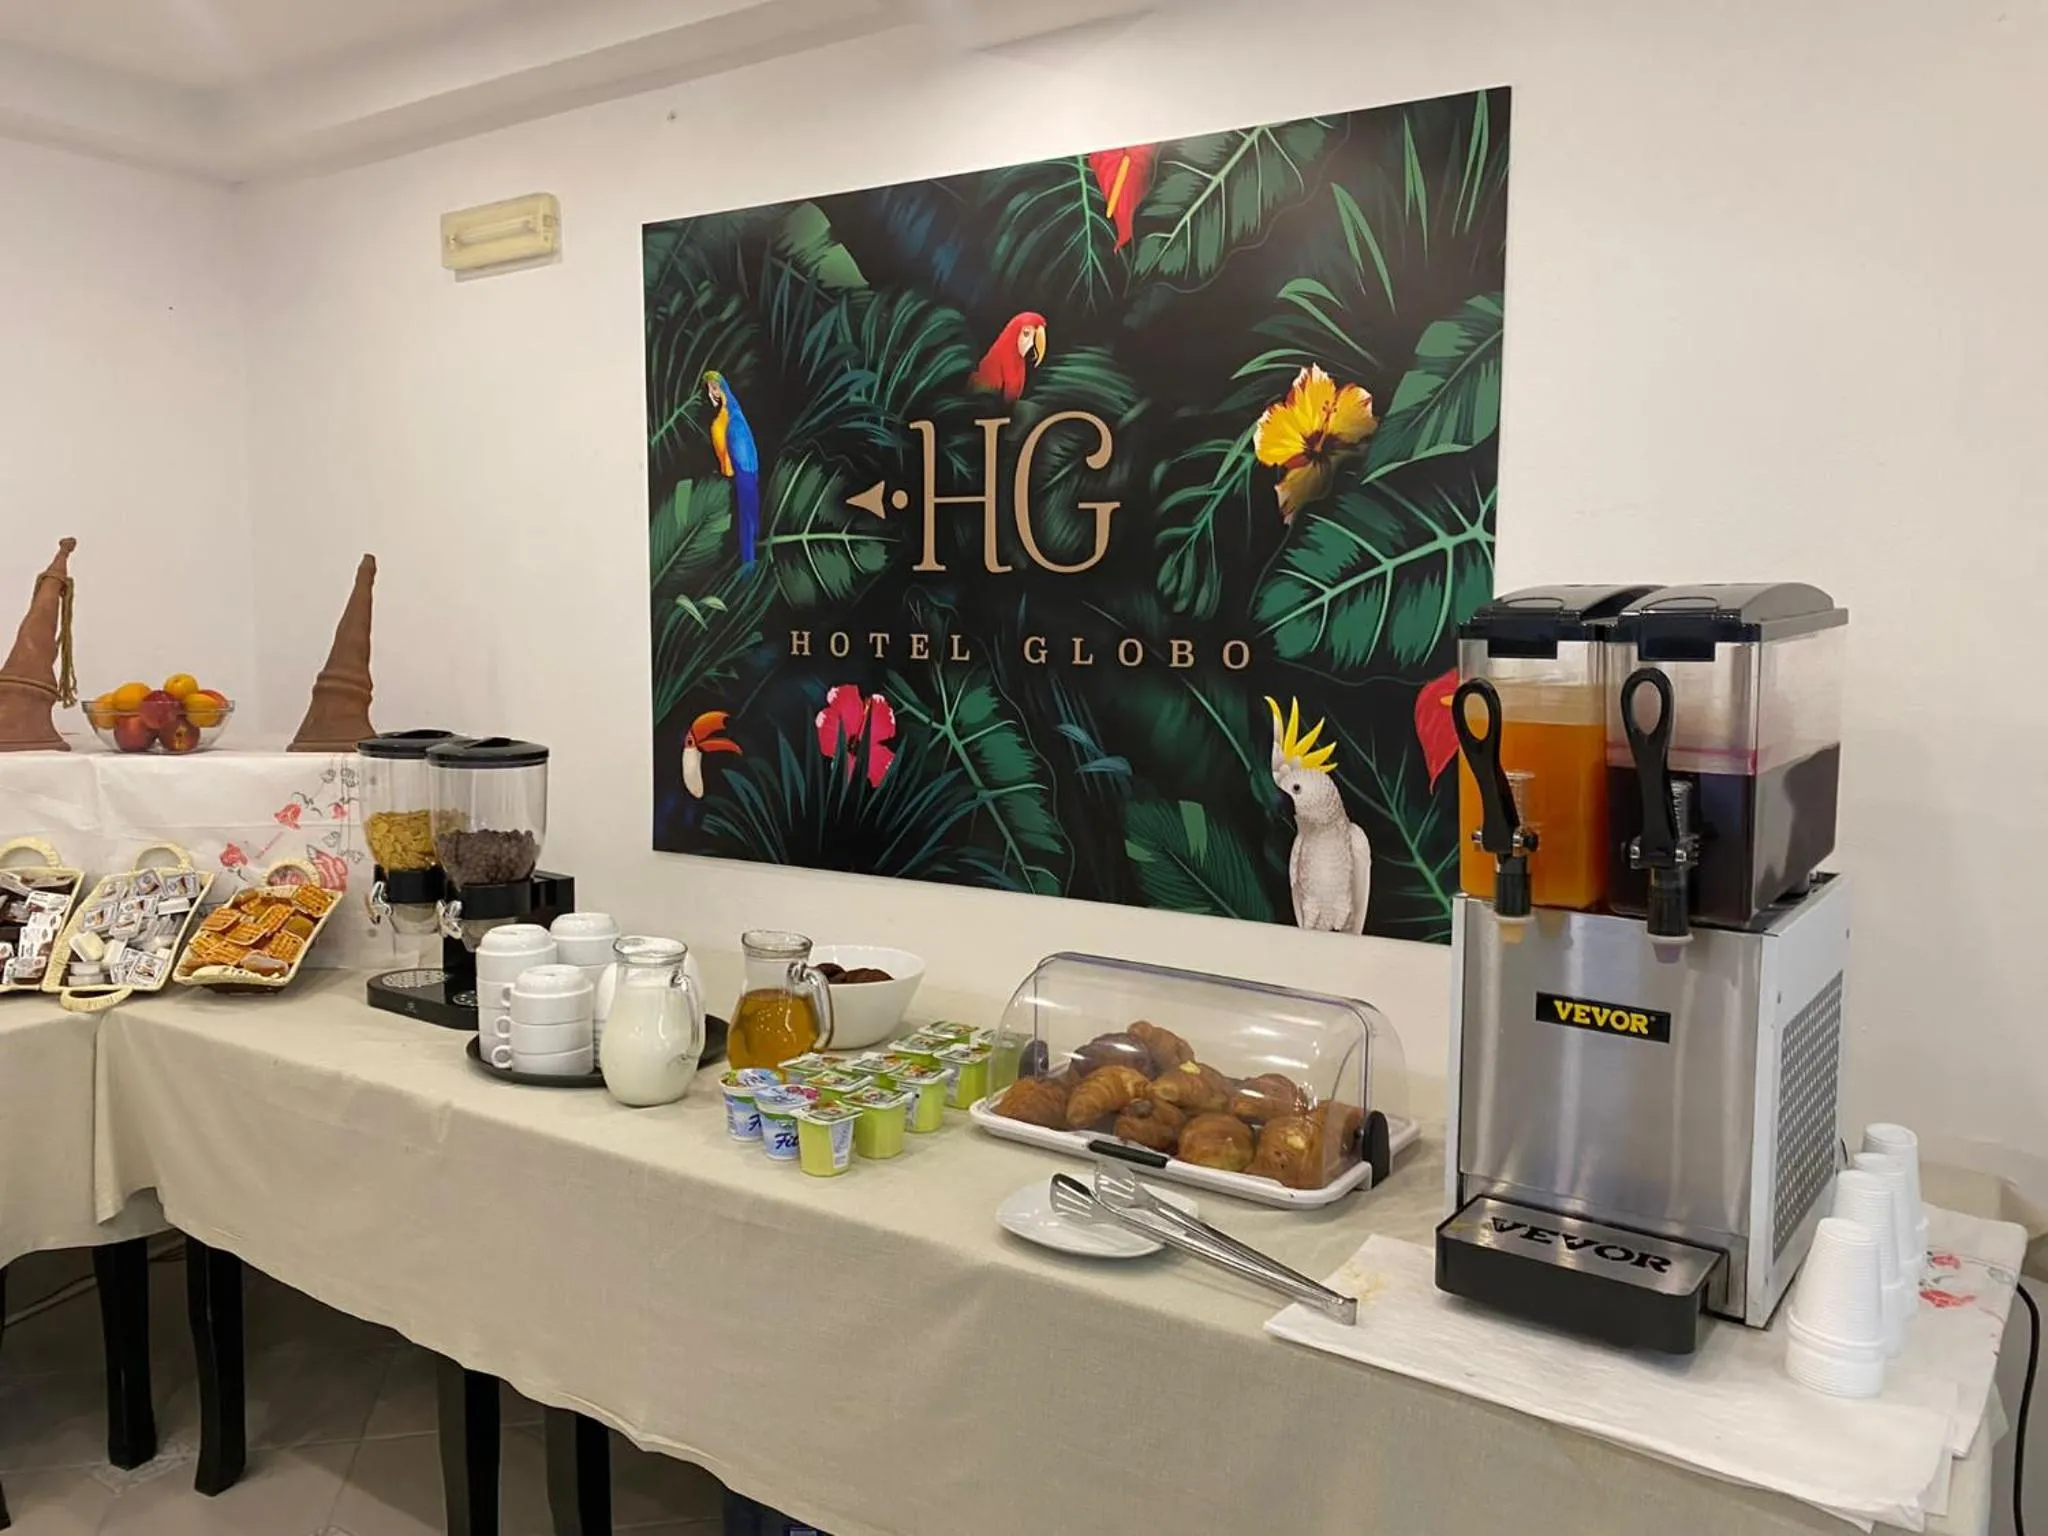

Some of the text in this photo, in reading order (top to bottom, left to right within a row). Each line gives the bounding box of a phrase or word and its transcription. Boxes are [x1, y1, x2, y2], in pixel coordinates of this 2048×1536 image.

[909, 410, 1122, 573] HG
[790, 630, 1252, 671] HOTEL GLOBO
[1553, 999, 1649, 1035] VEVOR
[1491, 1216, 1672, 1274] VEVOR
